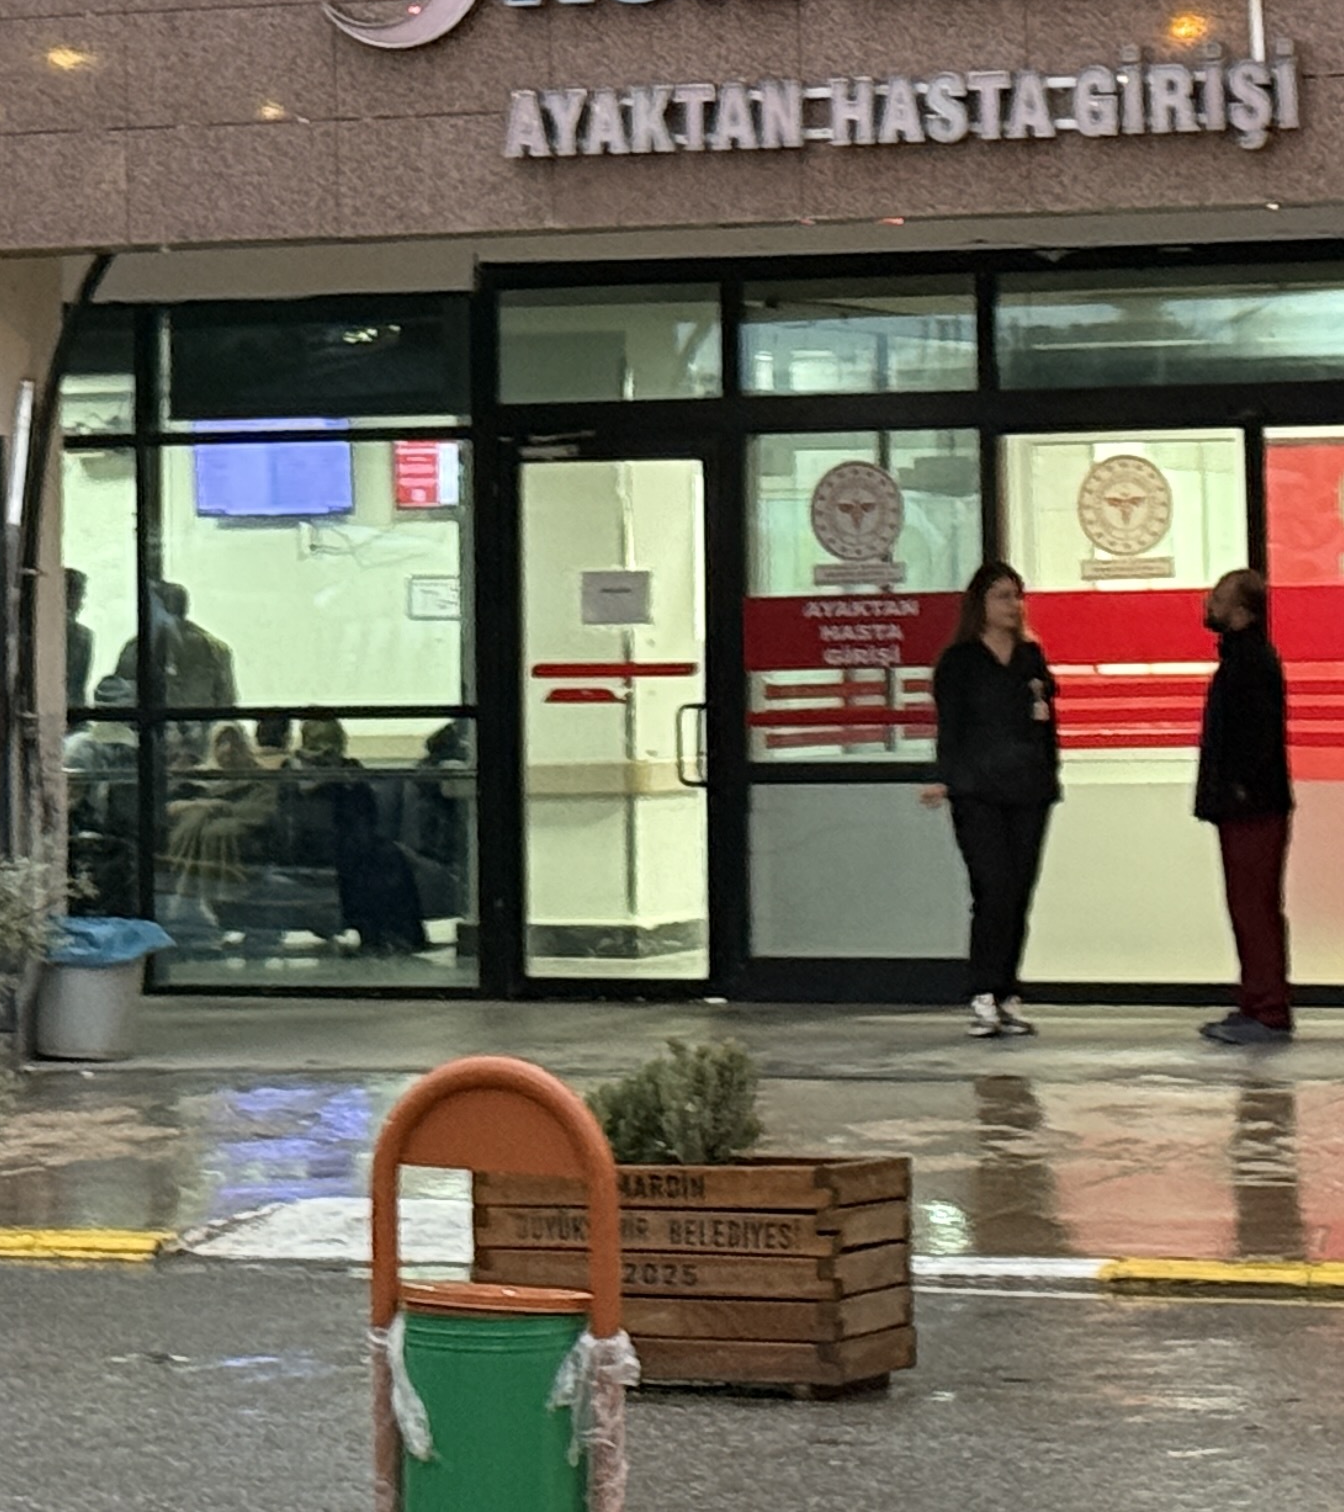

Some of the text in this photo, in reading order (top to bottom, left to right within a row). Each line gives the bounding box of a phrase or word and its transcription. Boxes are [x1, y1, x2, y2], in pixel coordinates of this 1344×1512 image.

[504, 38, 1300, 158] AYAKTAN HASTA GİRİŞİ
[802, 598, 920, 618] AYAKTAN
[818, 622, 905, 642] HASTA
